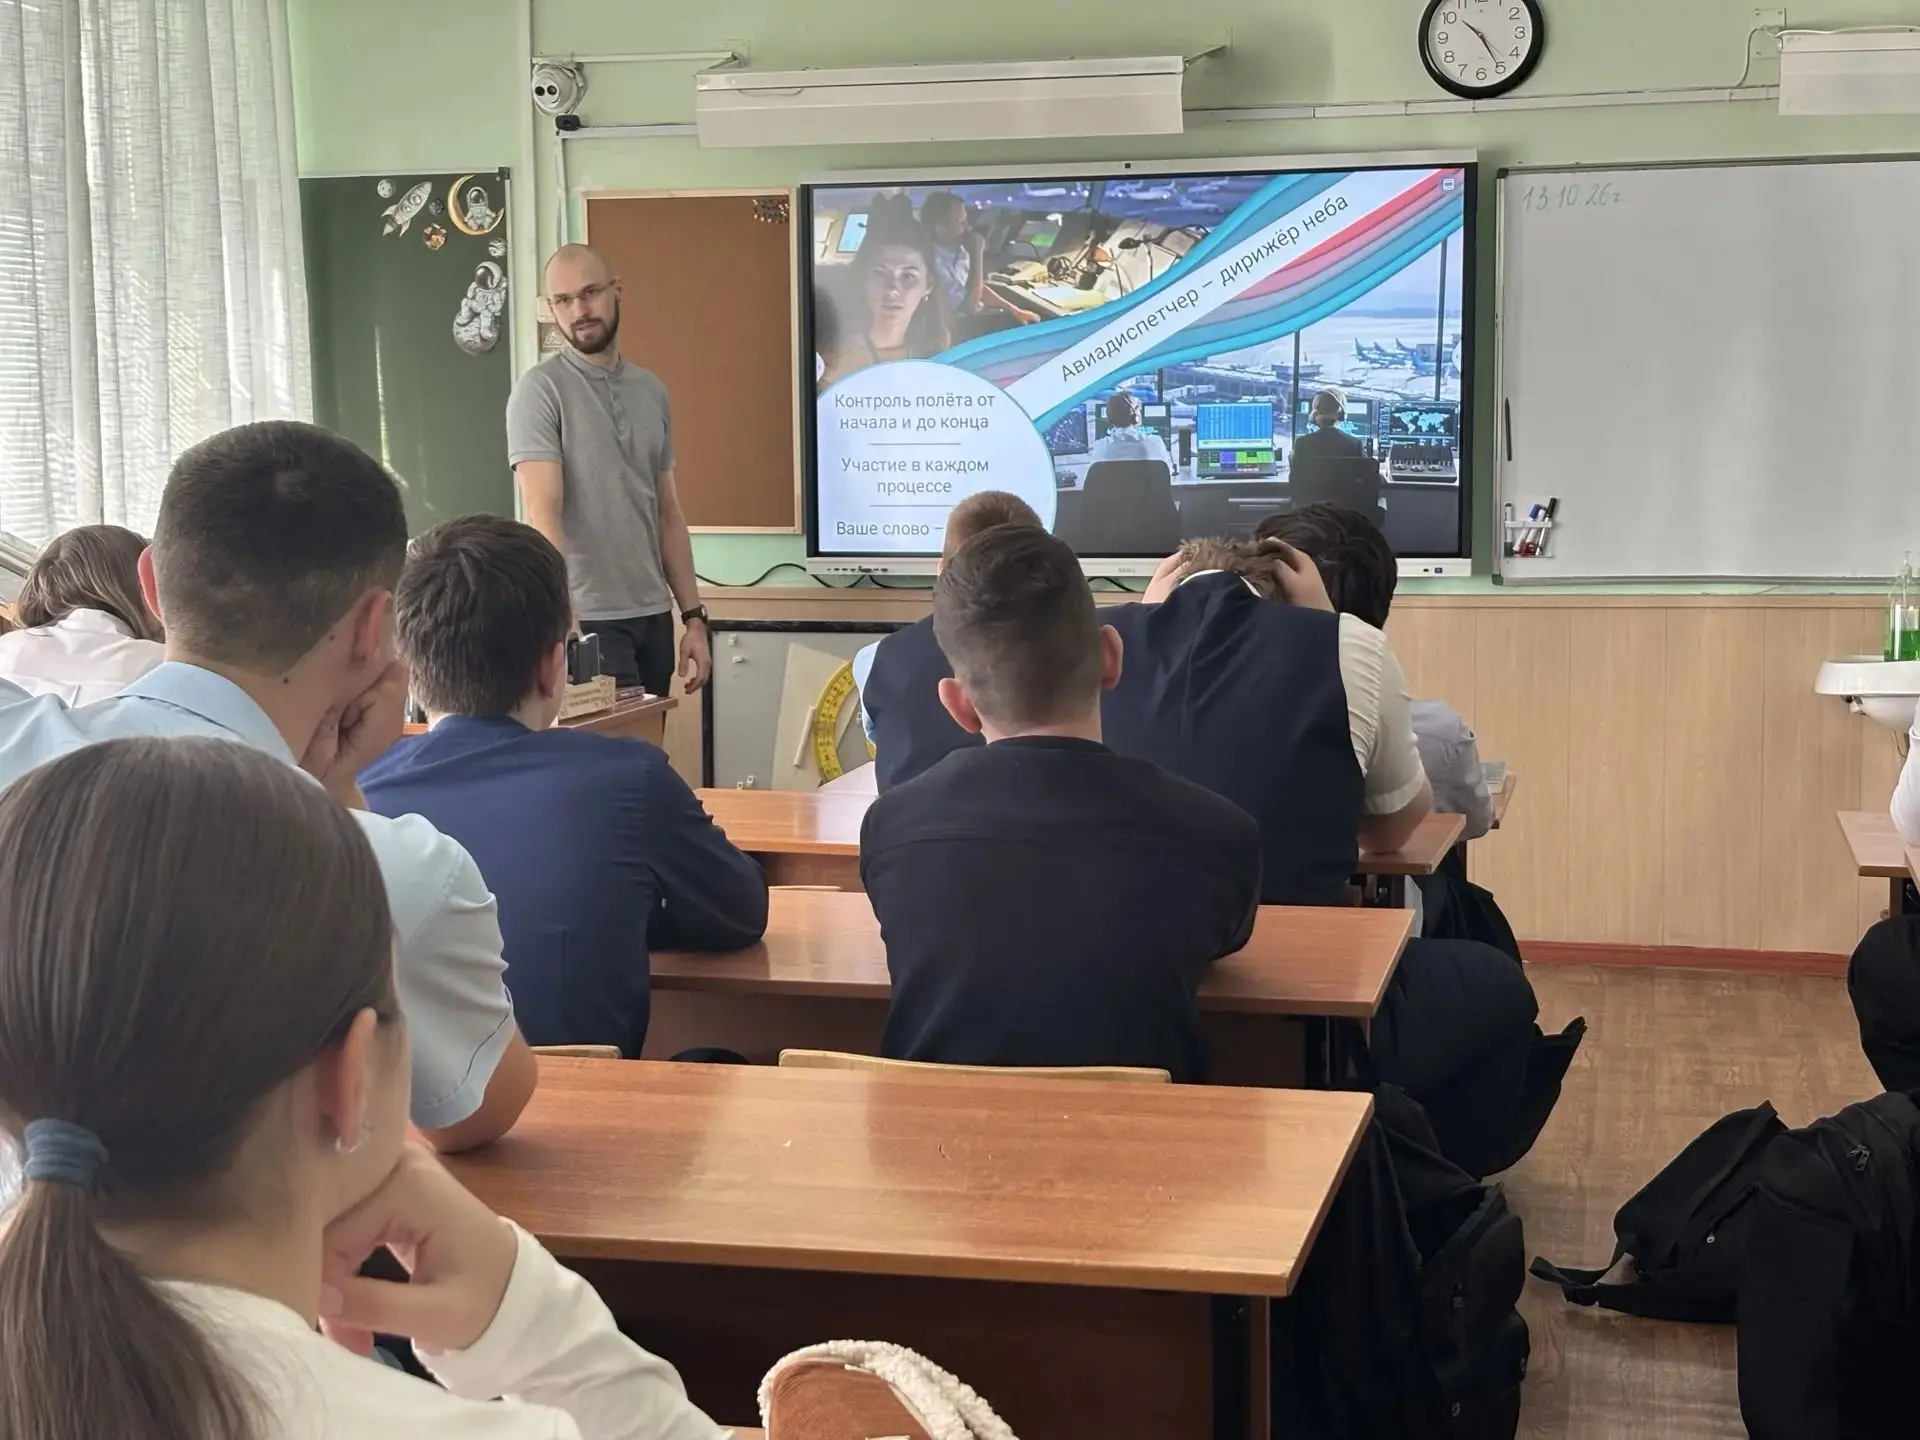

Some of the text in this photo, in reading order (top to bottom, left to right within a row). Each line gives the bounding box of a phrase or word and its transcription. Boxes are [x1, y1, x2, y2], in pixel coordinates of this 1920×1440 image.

[1442, 11, 1457, 24] 10
[1508, 6, 1521, 20] 2
[1437, 31, 1449, 44] 9
[1514, 26, 1526, 39] 3
[1443, 50, 1455, 63] 8
[1508, 46, 1520, 59] 4
[1457, 63, 1468, 76] 7
[1475, 67, 1487, 80] 6
[1494, 61, 1507, 74] 5
[1061, 288, 1199, 382] Авиадиспетчер
[1219, 228, 1300, 287] дирижёр
[1302, 196, 1349, 232] неба
[835, 392, 996, 410] Контроль полёта от
[839, 415, 989, 431] начала и до конца
[841, 457, 989, 474] Участие в каждом
[877, 481, 952, 494] процессе
[836, 521, 878, 535] Ваше
[882, 523, 930, 536] слово
